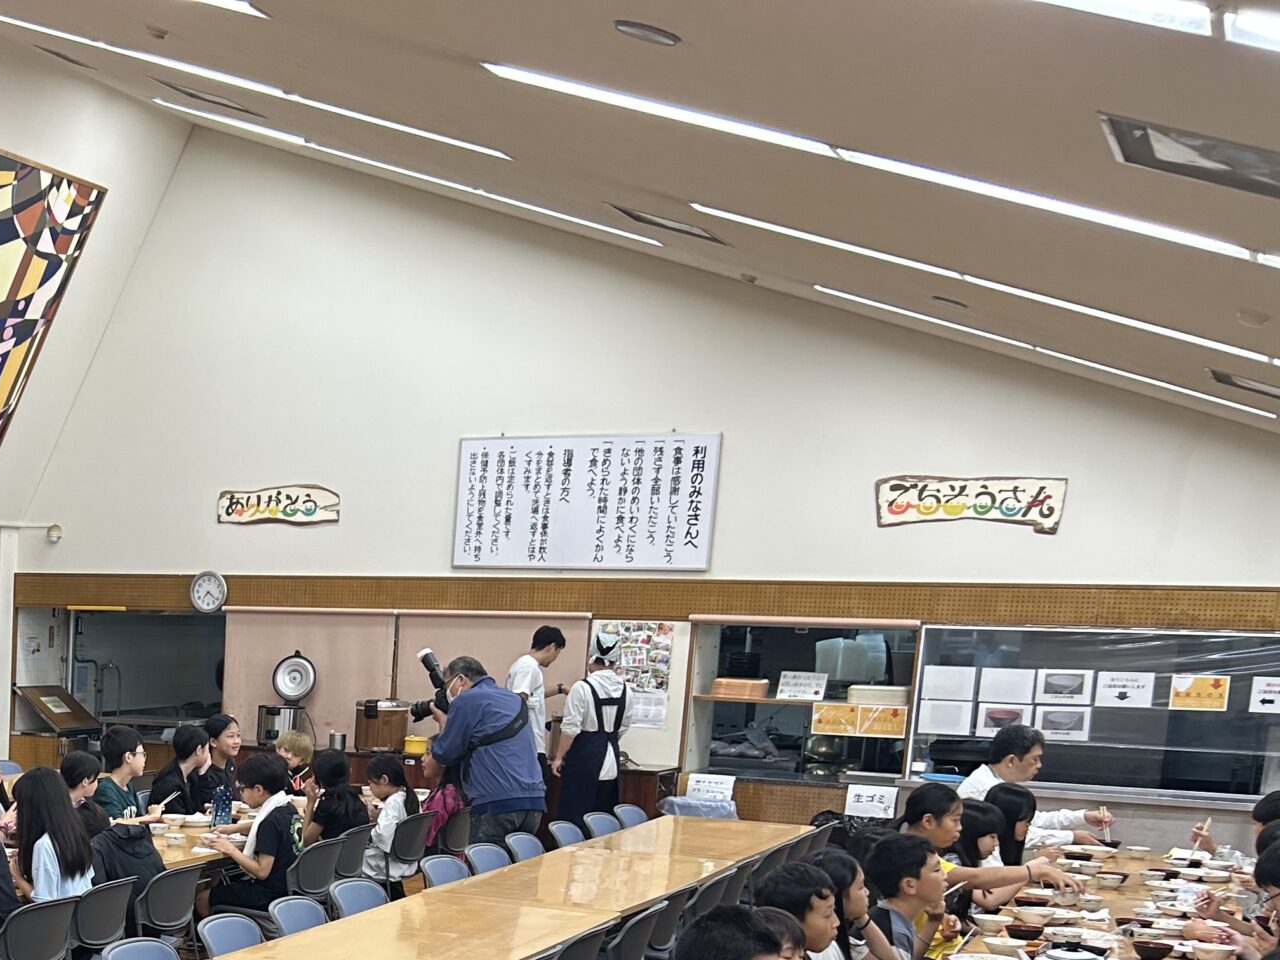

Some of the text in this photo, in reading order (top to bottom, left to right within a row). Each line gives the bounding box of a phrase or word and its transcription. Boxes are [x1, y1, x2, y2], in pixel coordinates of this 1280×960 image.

[559, 449, 574, 503] 指導者の方へ
[225, 490, 318, 518] ありがとう
[684, 445, 707, 549] 利用のみなさんへ
[852, 793, 885, 804] 生ゴミ
